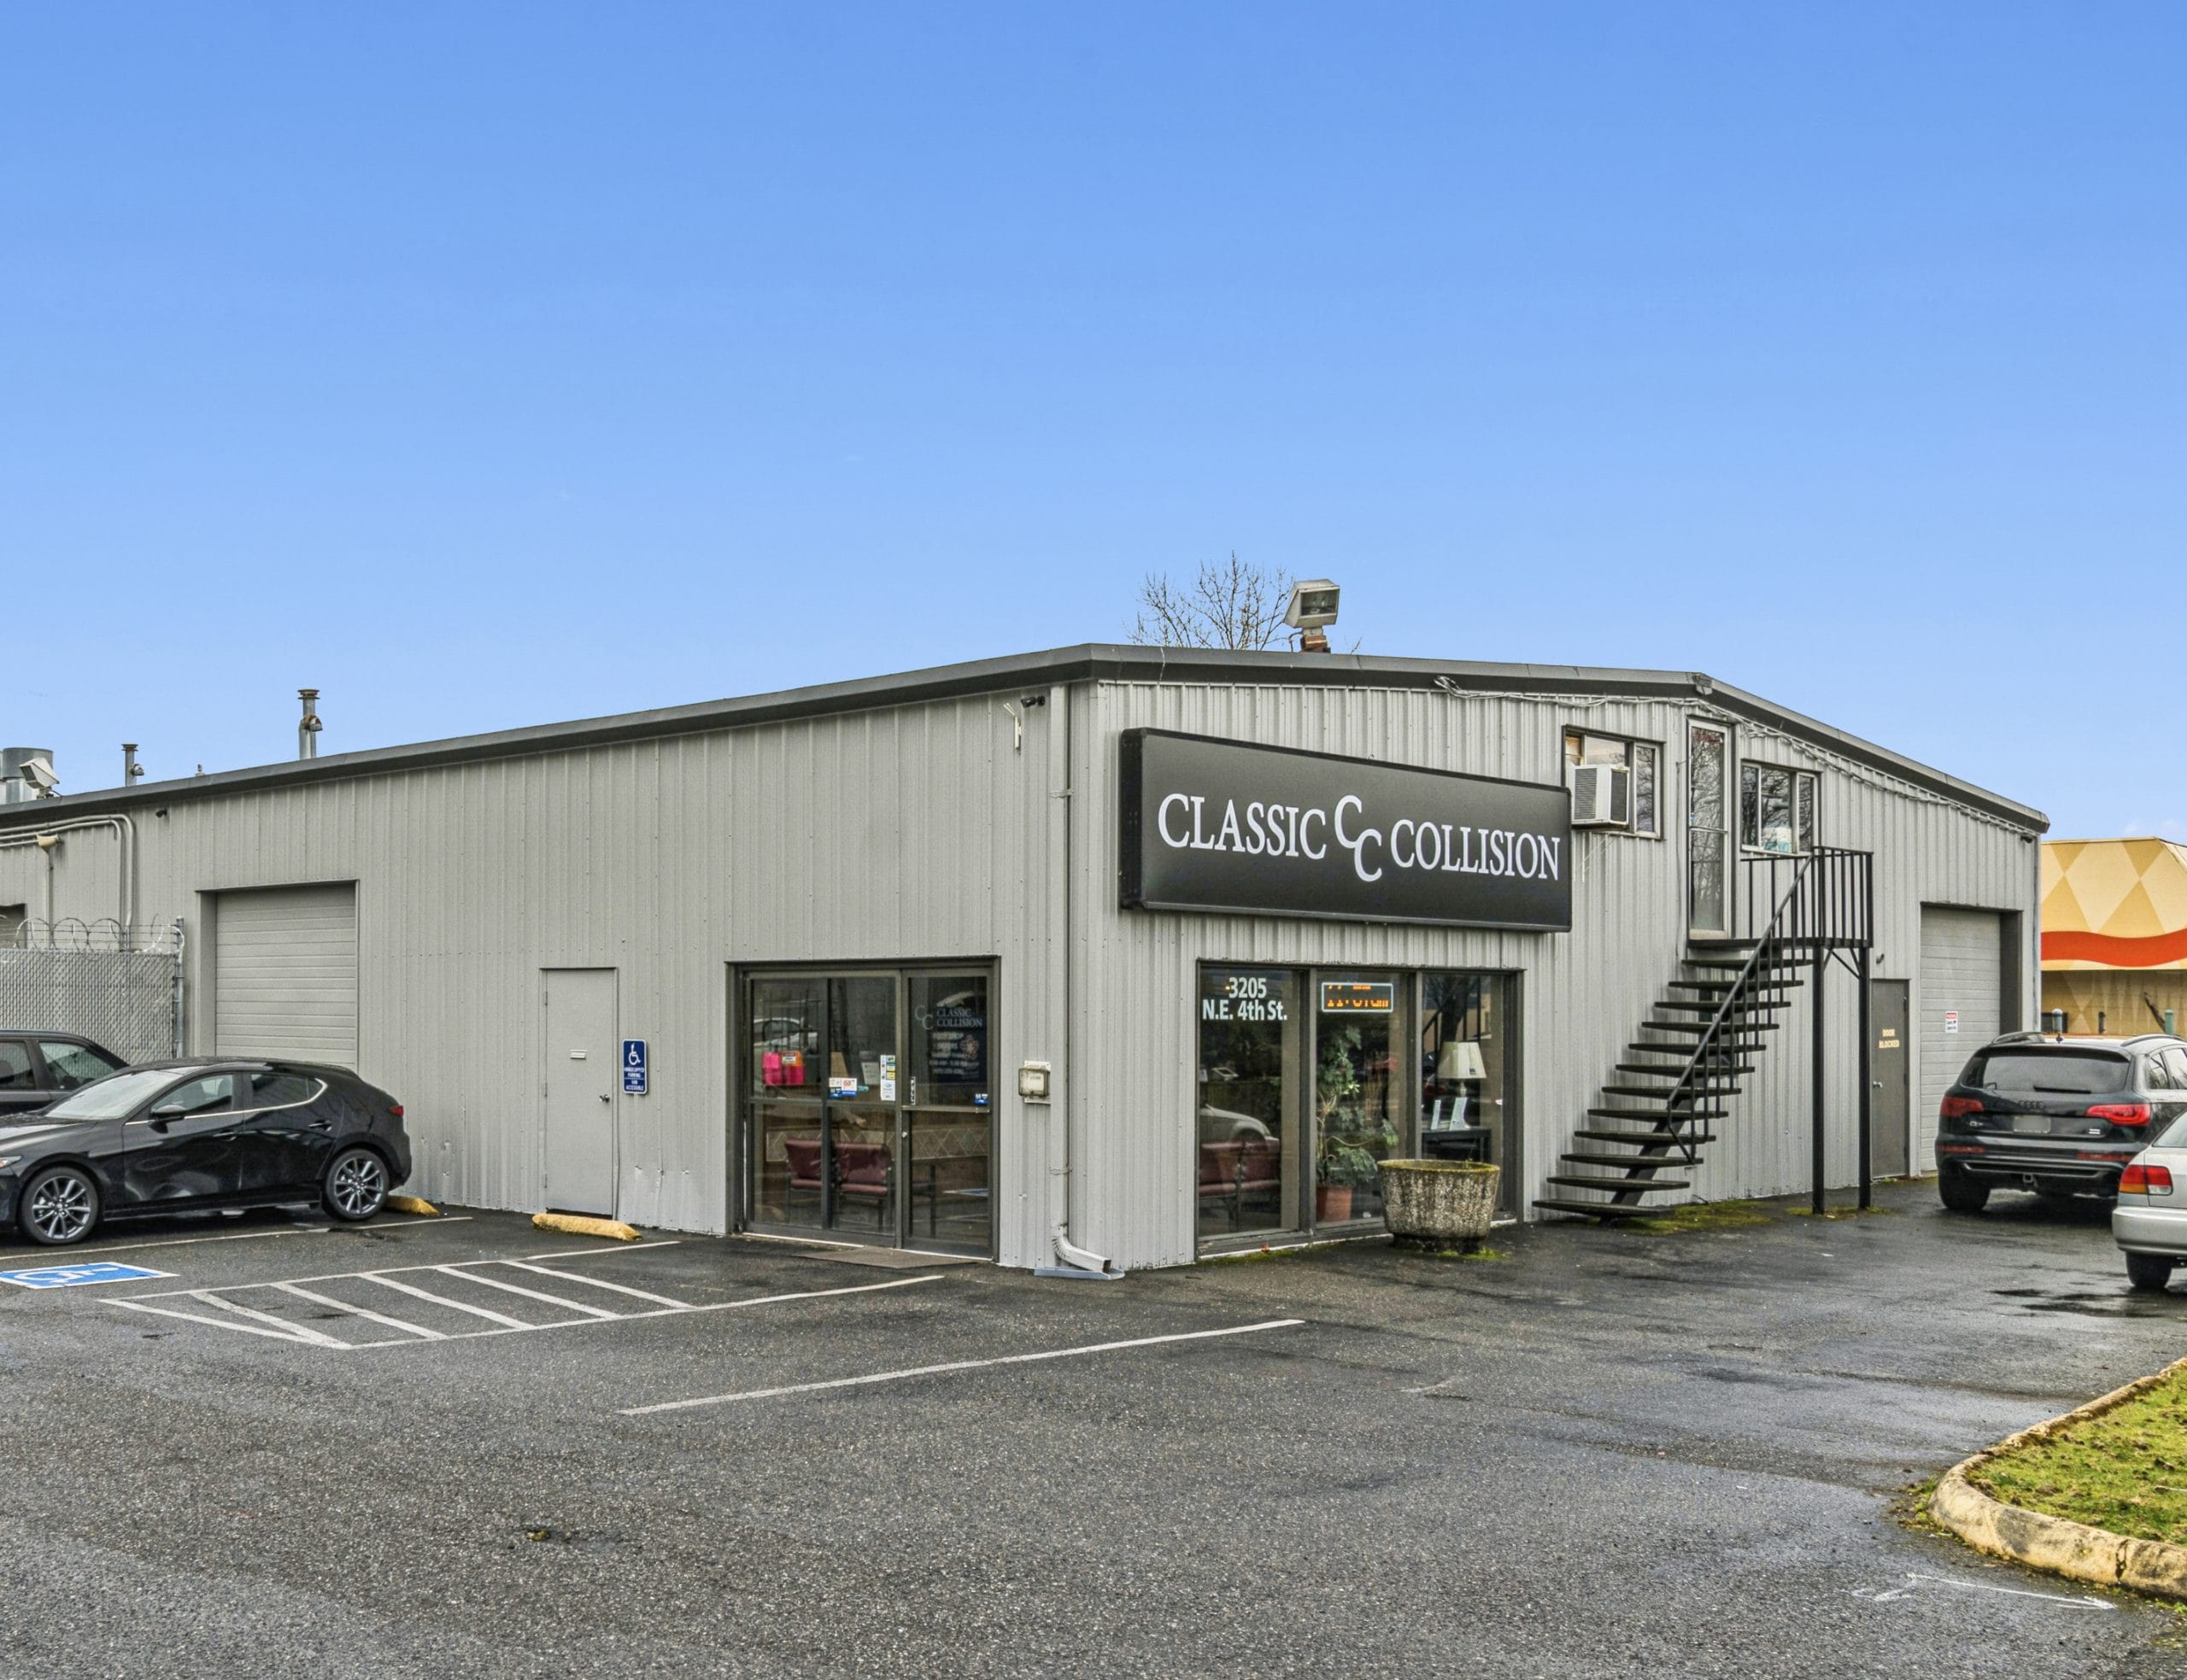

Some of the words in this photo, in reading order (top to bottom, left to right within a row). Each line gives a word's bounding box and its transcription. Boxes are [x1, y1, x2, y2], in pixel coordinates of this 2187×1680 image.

[1158, 793, 1327, 860] CLASSIC
[1390, 818, 1560, 881] COLLISION
[1228, 977, 1267, 999] 3205
[936, 1008, 971, 1018] CLASSIC
[1202, 998, 1234, 1021] N.E.
[1238, 999, 1265, 1021] 4th
[1267, 1000, 1288, 1021] St.
[936, 1017, 983, 1027] COLLISION
[1879, 1039, 1900, 1049] BLOCKED
